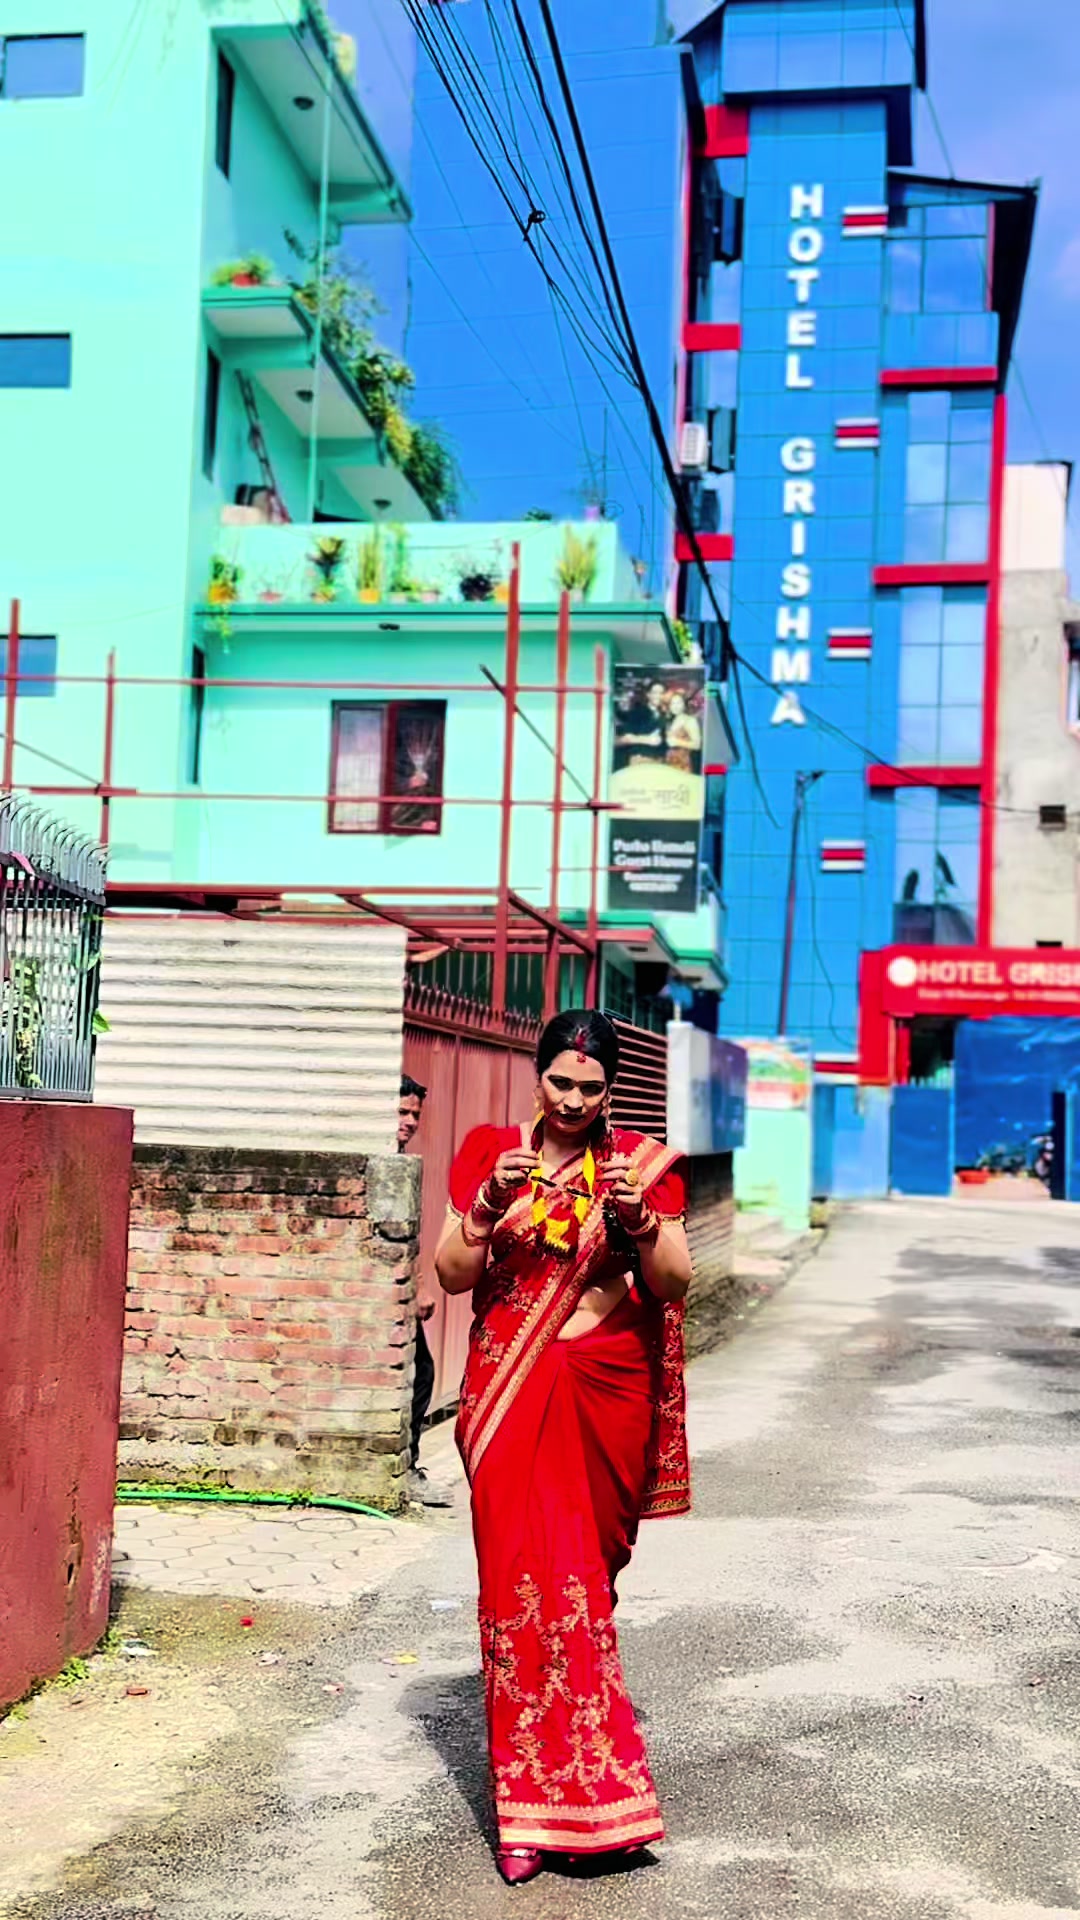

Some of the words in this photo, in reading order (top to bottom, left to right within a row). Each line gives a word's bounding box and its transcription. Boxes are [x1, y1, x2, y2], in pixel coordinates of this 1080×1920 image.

[786, 184, 823, 388] HOTEL
[770, 437, 816, 726] GRISHMA
[918, 960, 1003, 985] HOTEL
